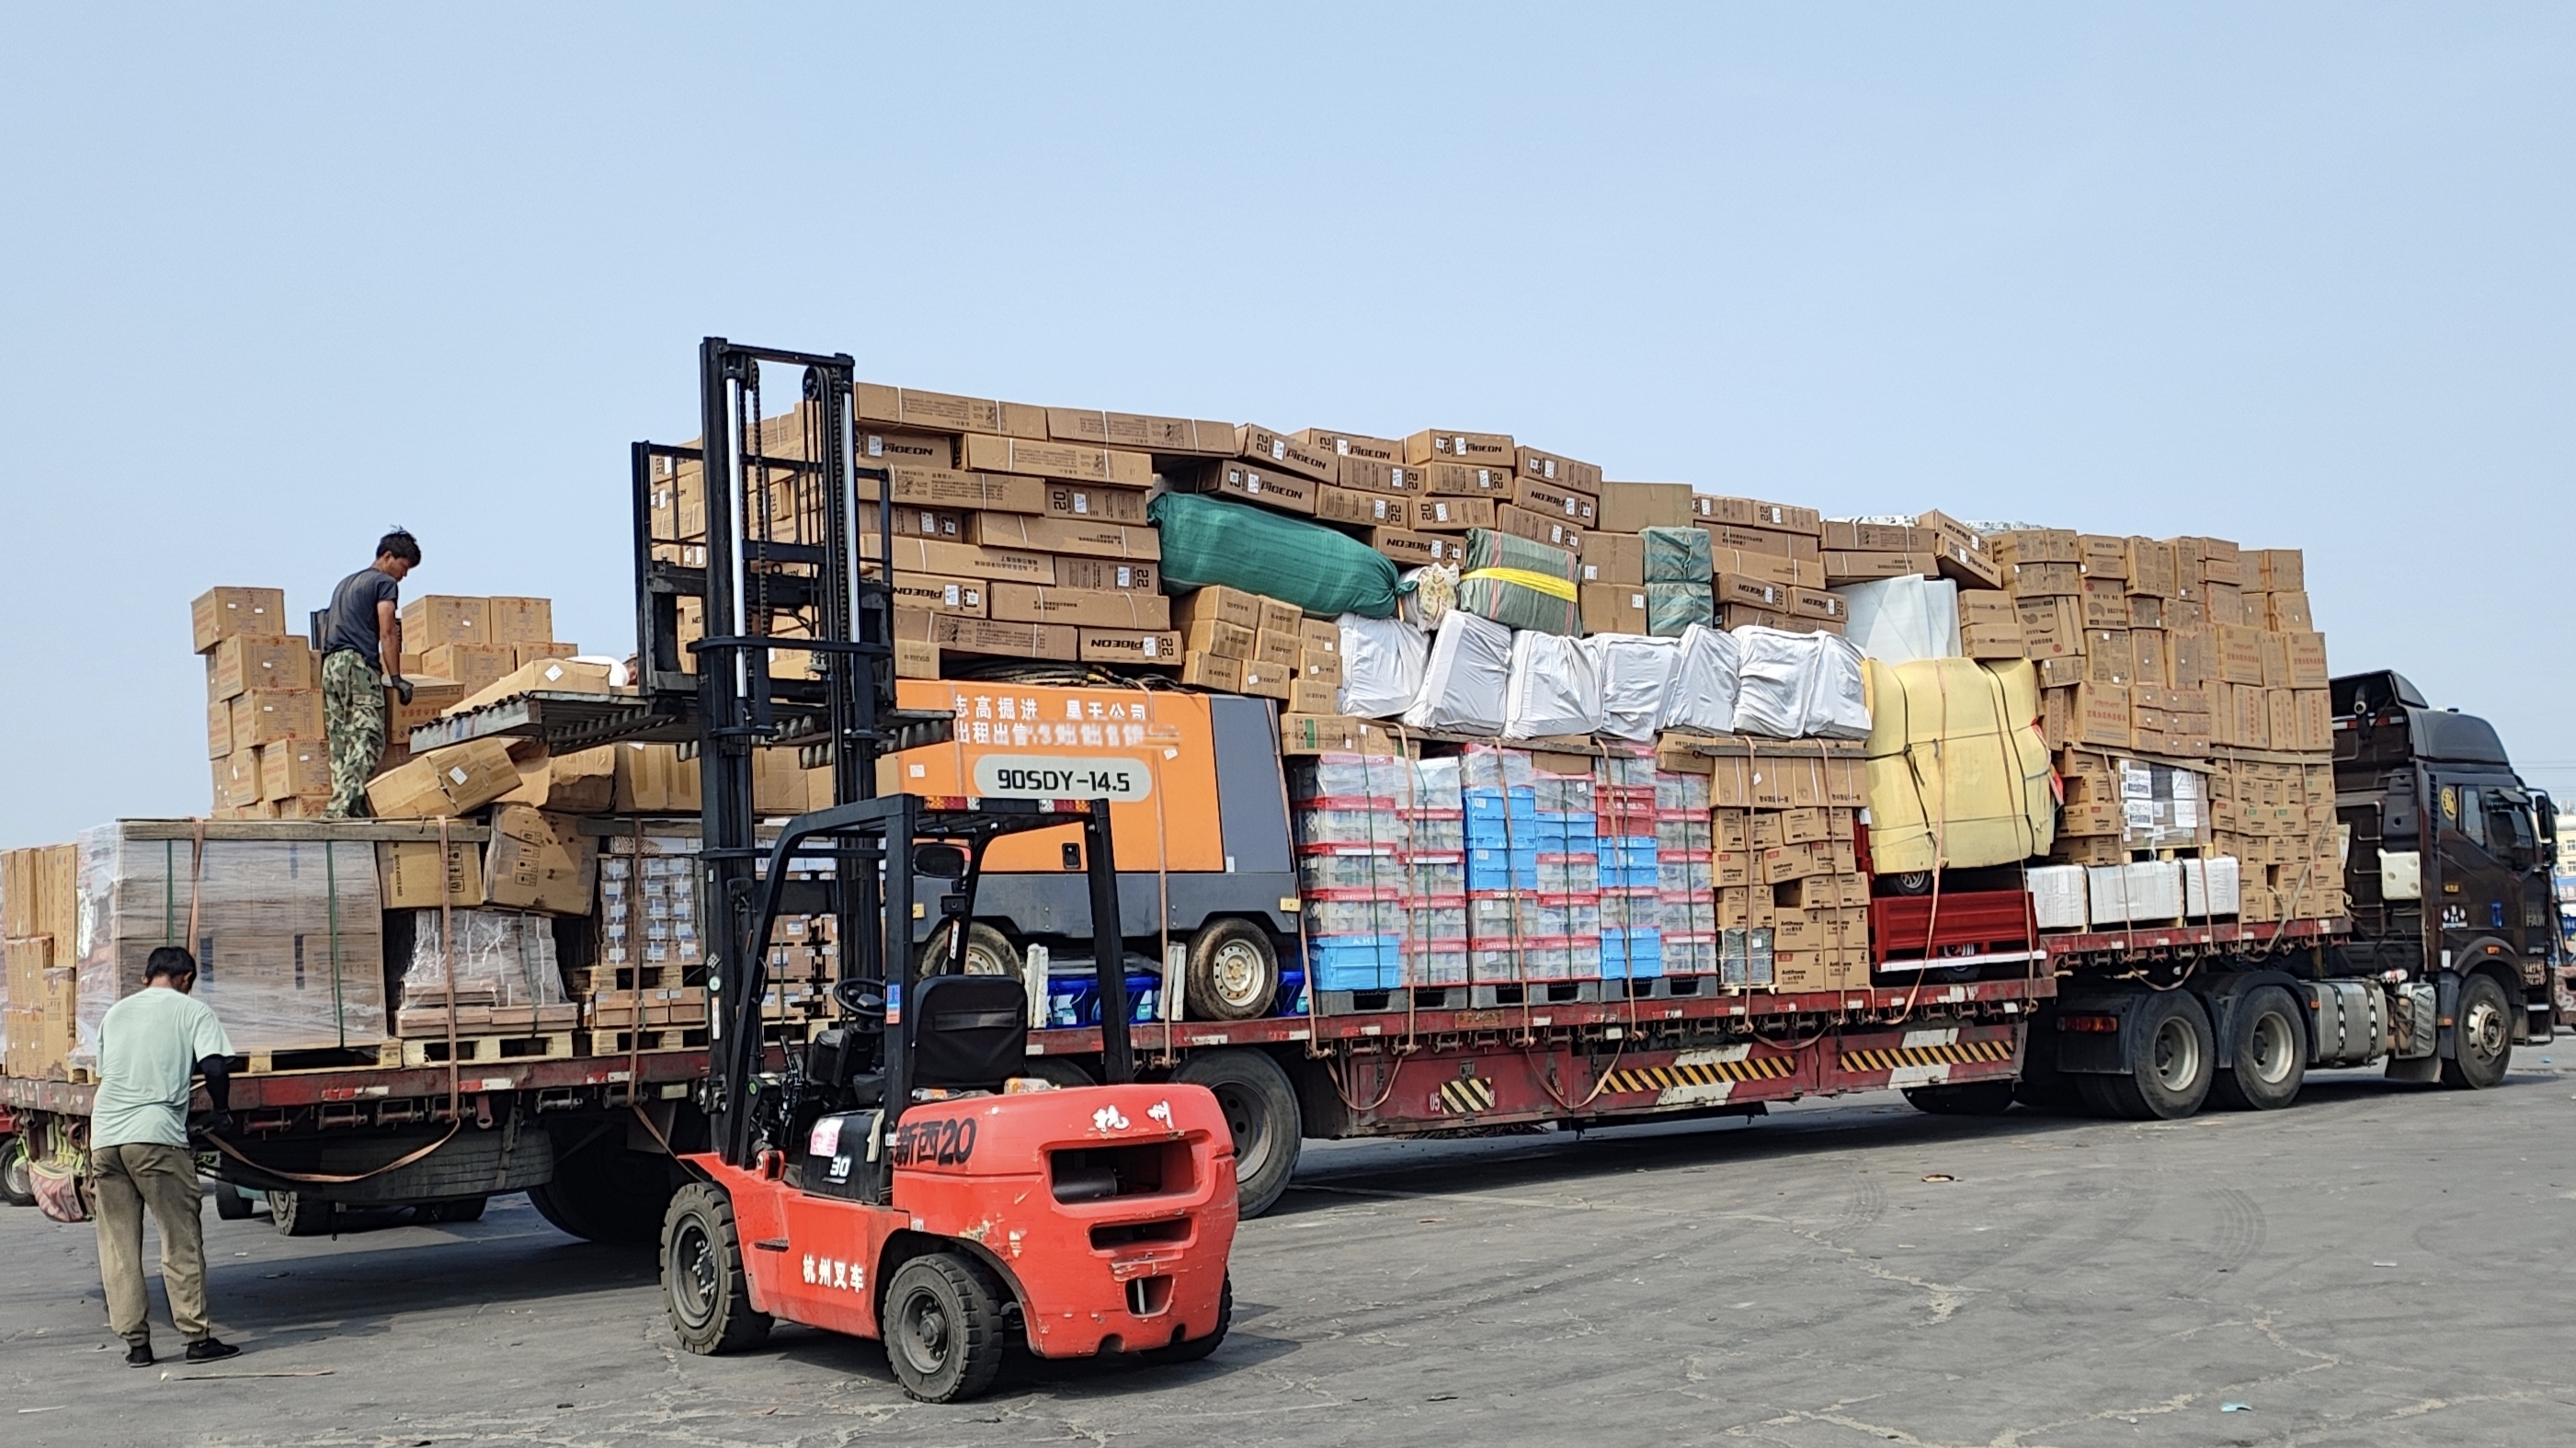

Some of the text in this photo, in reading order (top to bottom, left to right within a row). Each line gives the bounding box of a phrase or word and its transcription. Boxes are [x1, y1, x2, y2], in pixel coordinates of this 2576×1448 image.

[882, 442, 934, 456] PIGEON
[1256, 433, 1268, 453] 22
[1465, 442, 1502, 453] PIGEON
[1286, 447, 1327, 471] PIGEON
[1350, 445, 1391, 460] PIGEON
[1260, 480, 1303, 500] PIGEON
[1408, 473, 1419, 490] 22
[1493, 473, 1503, 489] 22
[1054, 491, 1066, 510] 20
[1390, 504, 1401, 522] 22
[1420, 503, 1431, 521] 20
[1760, 506, 1769, 521] 22
[1137, 569, 1149, 588] 22
[1090, 639, 1144, 651] PIGEON
[1161, 637, 1174, 656] 22
[997, 769, 1131, 792] 90SDY-14.5
[2525, 915, 2546, 928] FAW
[830, 1156, 850, 1178] 30
[803, 1253, 864, 1294] 杭州叉车
